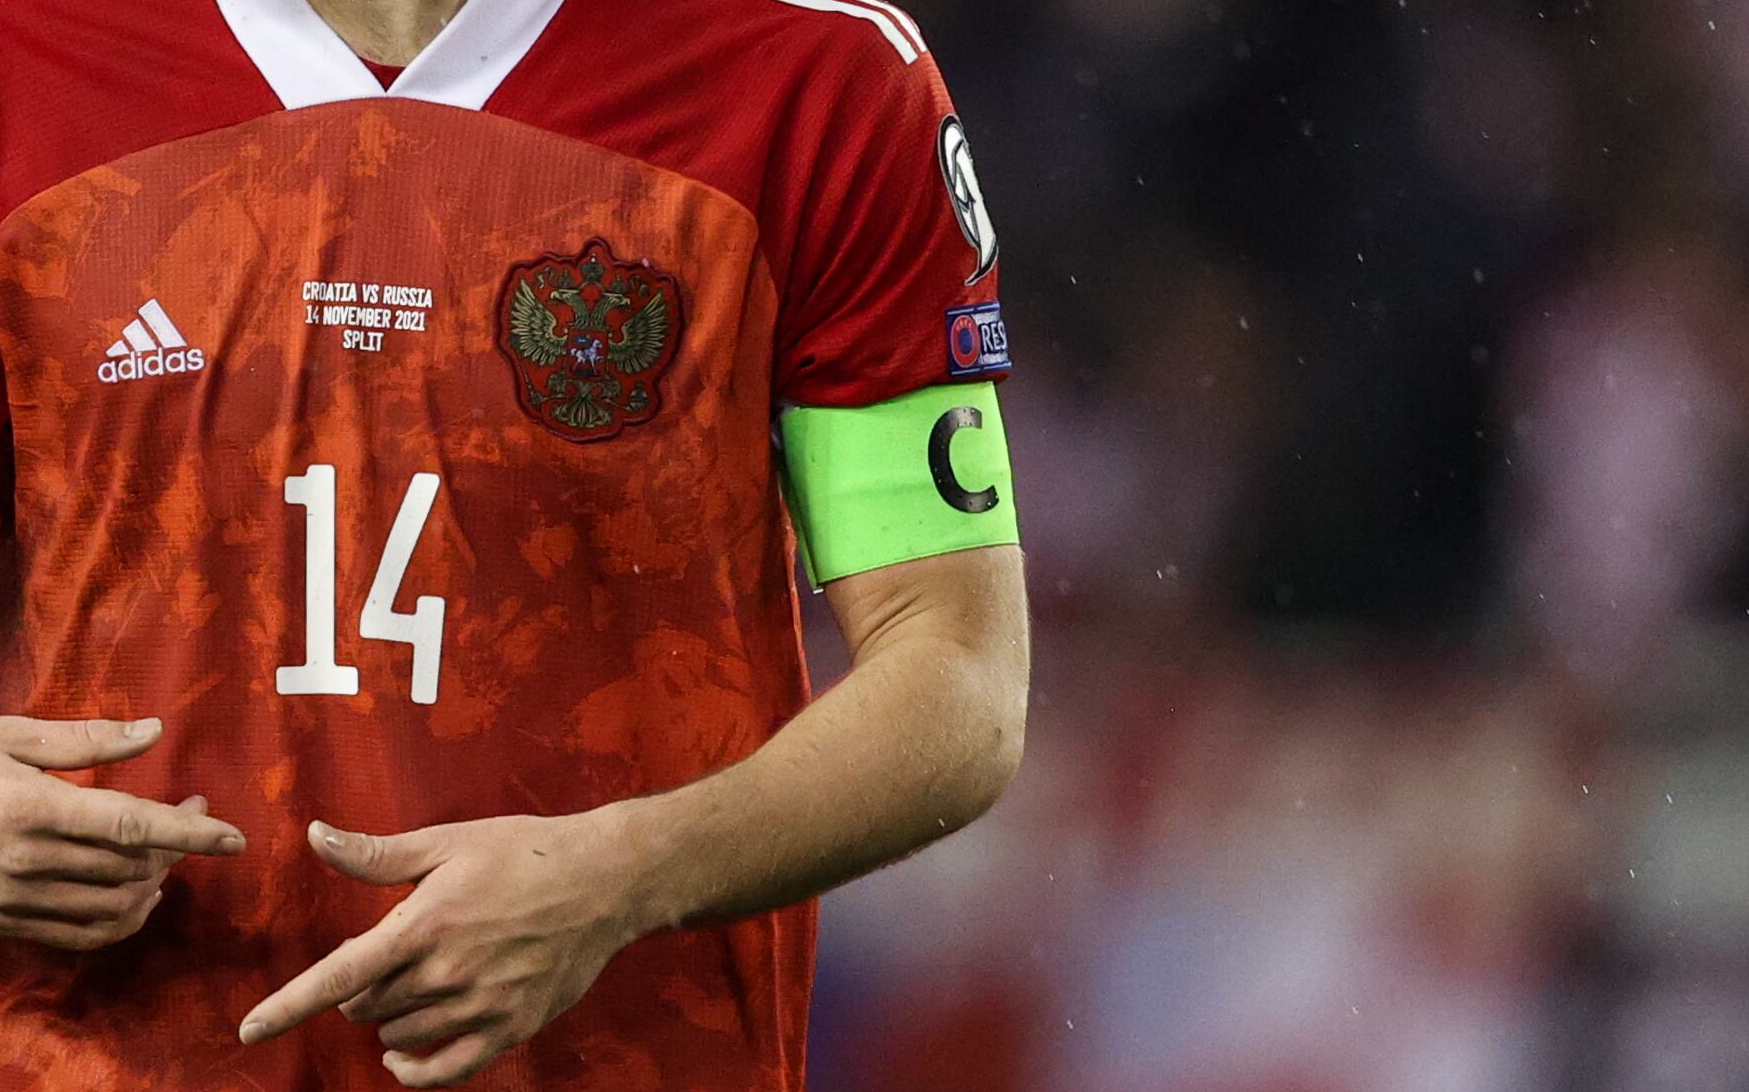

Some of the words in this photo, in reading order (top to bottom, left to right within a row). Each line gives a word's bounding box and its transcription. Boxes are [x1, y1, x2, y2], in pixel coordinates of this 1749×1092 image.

[302, 281, 357, 302] CROATIA
[362, 283, 379, 304] VS
[382, 285, 433, 308] RUSSIA
[305, 305, 319, 324] 14
[323, 306, 391, 328] NOVEMBER
[394, 310, 425, 331] 2021
[342, 329, 384, 352] SPLIT
[97, 348, 205, 383] adidas
[928, 406, 999, 514] C
[276, 464, 446, 705] 14
